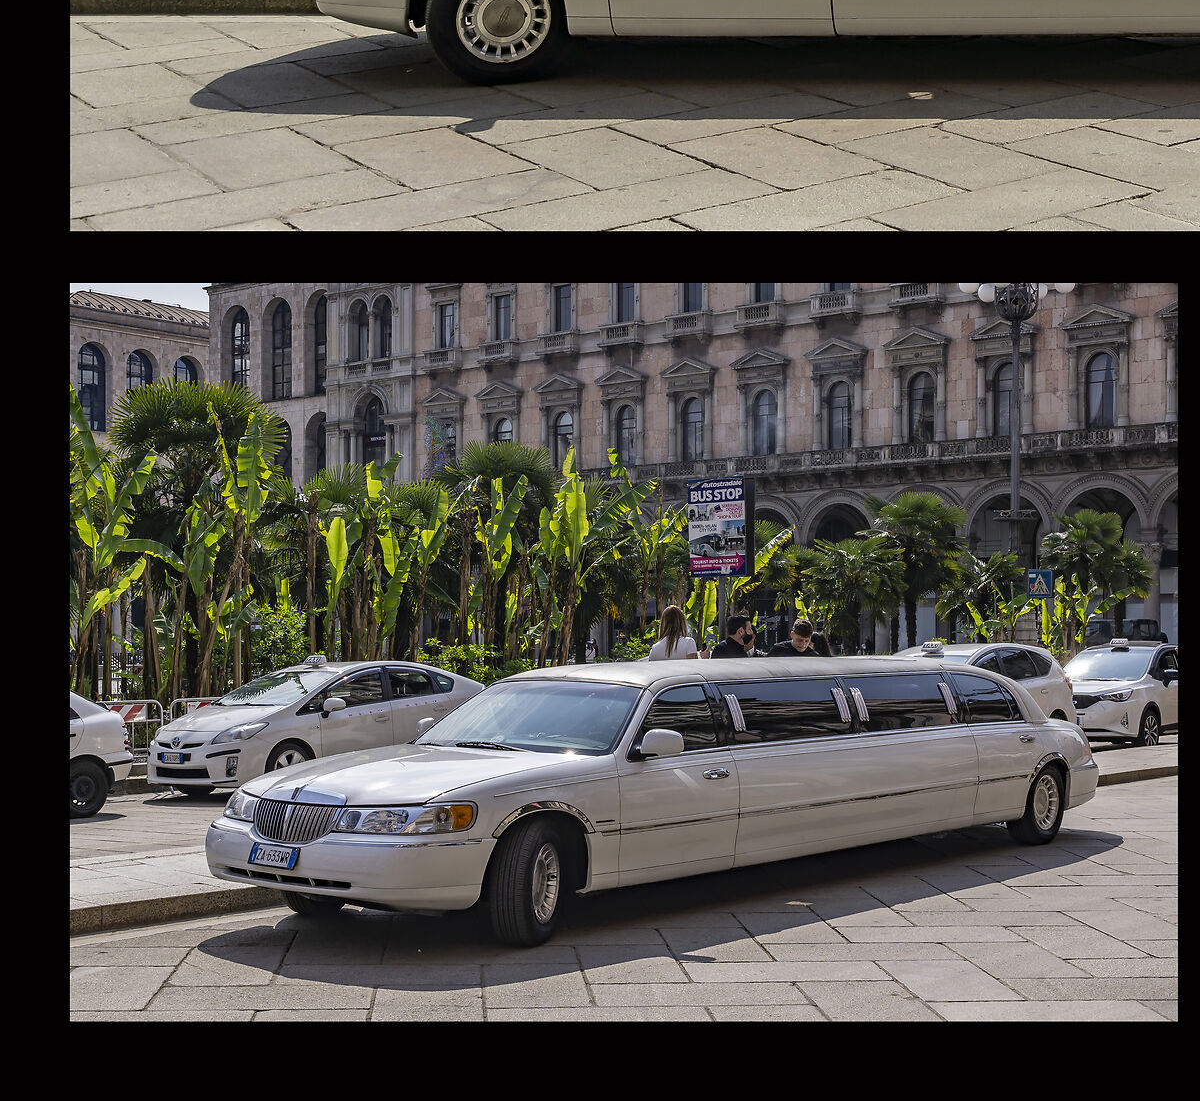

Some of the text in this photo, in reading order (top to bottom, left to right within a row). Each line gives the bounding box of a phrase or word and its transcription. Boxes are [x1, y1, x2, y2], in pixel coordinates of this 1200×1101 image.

[701, 480, 742, 488] Autostradale
[690, 488, 743, 502] BUS STOP
